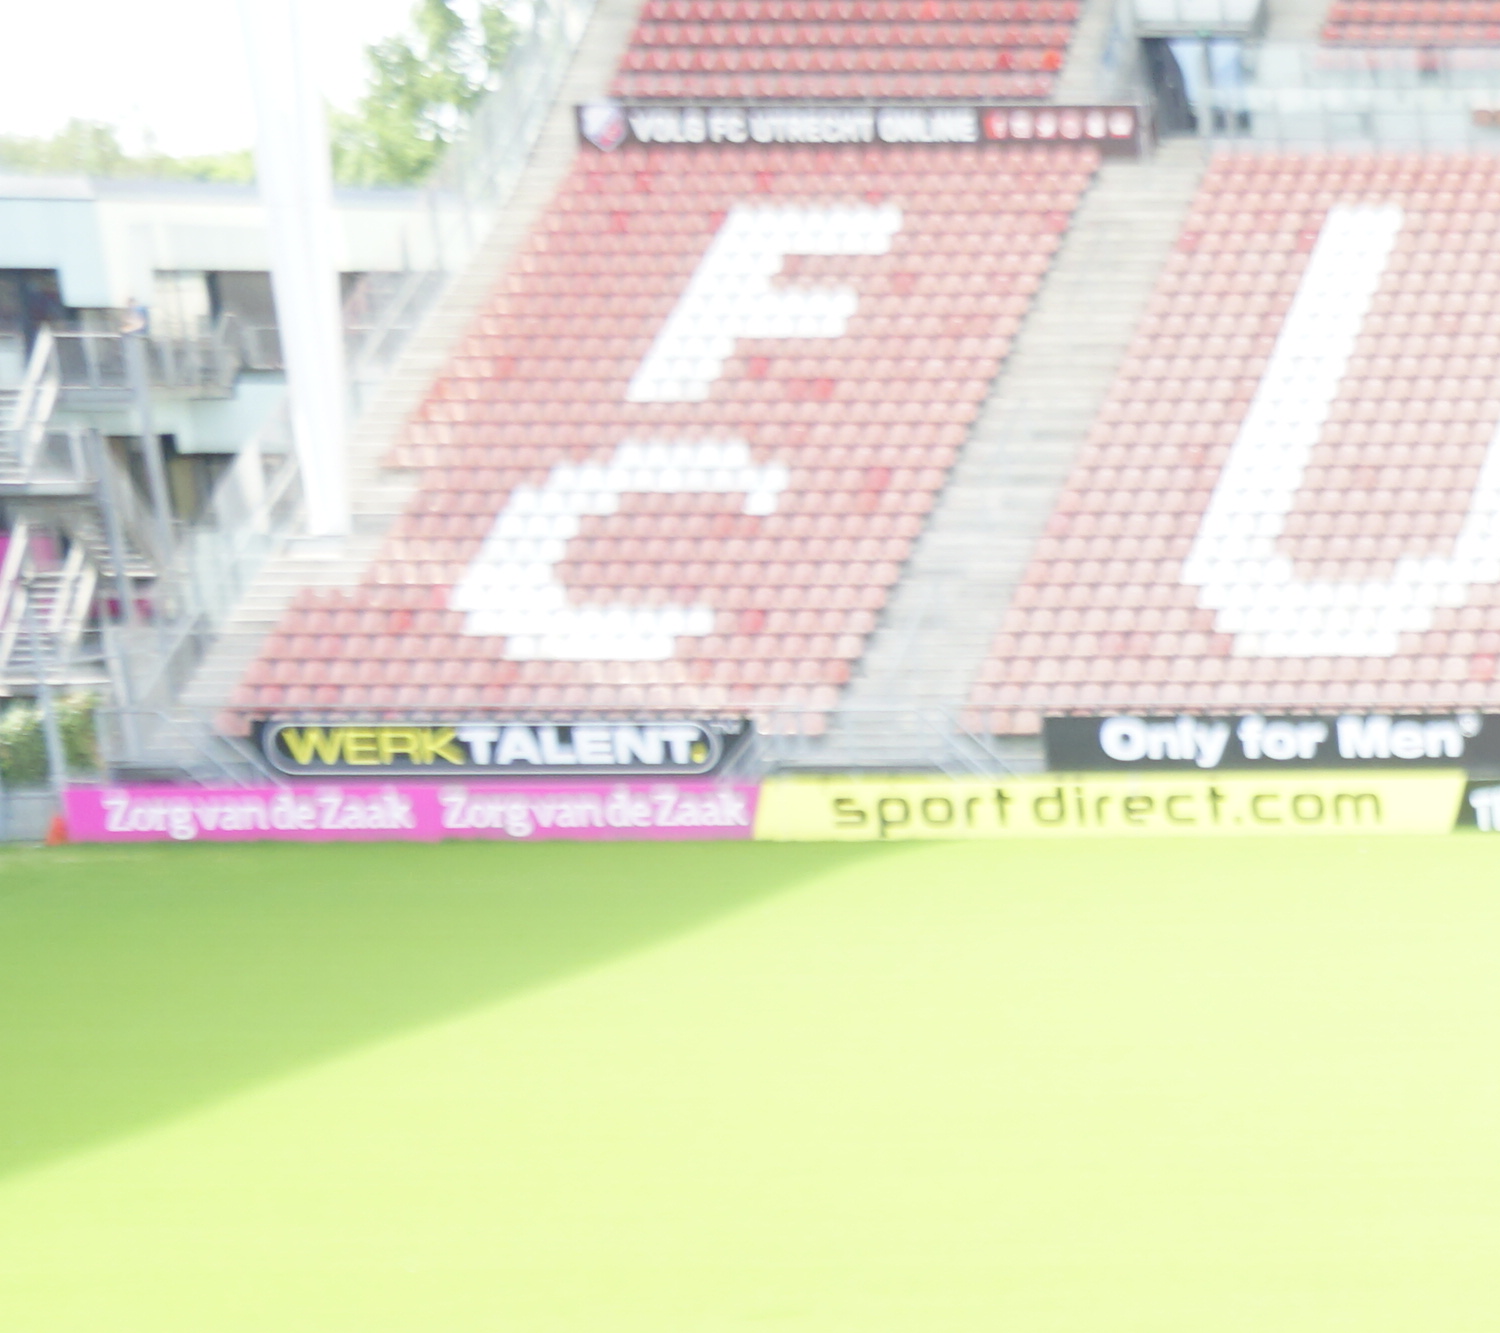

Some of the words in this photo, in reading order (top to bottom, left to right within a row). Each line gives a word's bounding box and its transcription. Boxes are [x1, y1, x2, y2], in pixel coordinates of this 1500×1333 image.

[628, 105, 706, 143] VOLG
[708, 105, 747, 143] FC
[747, 105, 874, 143] UTRECHT
[876, 105, 979, 143] ONLINE
[1100, 713, 1230, 768] Only
[1237, 713, 1328, 760] for
